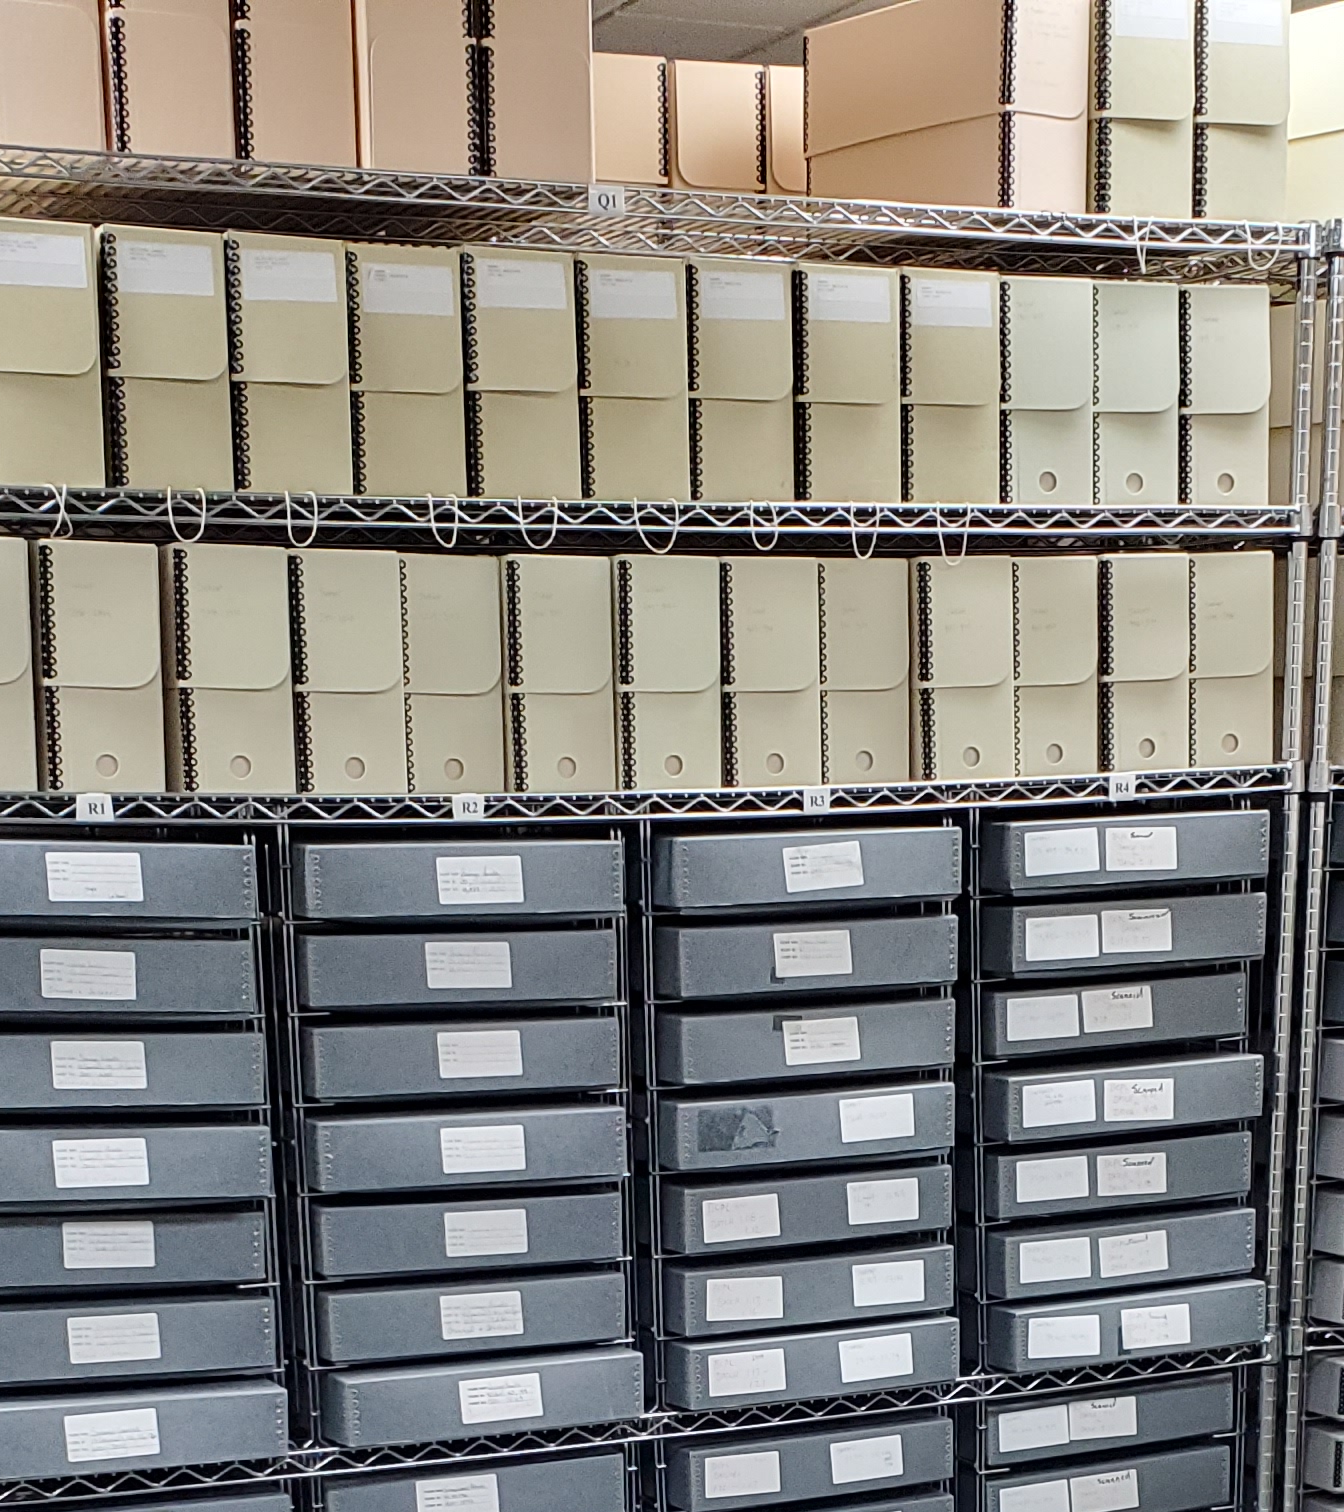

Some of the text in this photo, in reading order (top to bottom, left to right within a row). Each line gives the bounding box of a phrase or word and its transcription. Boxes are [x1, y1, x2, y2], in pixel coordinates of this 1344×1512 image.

[598, 193, 617, 210] Q1
[1115, 782, 1130, 794] R4
[88, 802, 106, 815] R1
[462, 801, 479, 814] R2
[810, 796, 825, 809] R3
